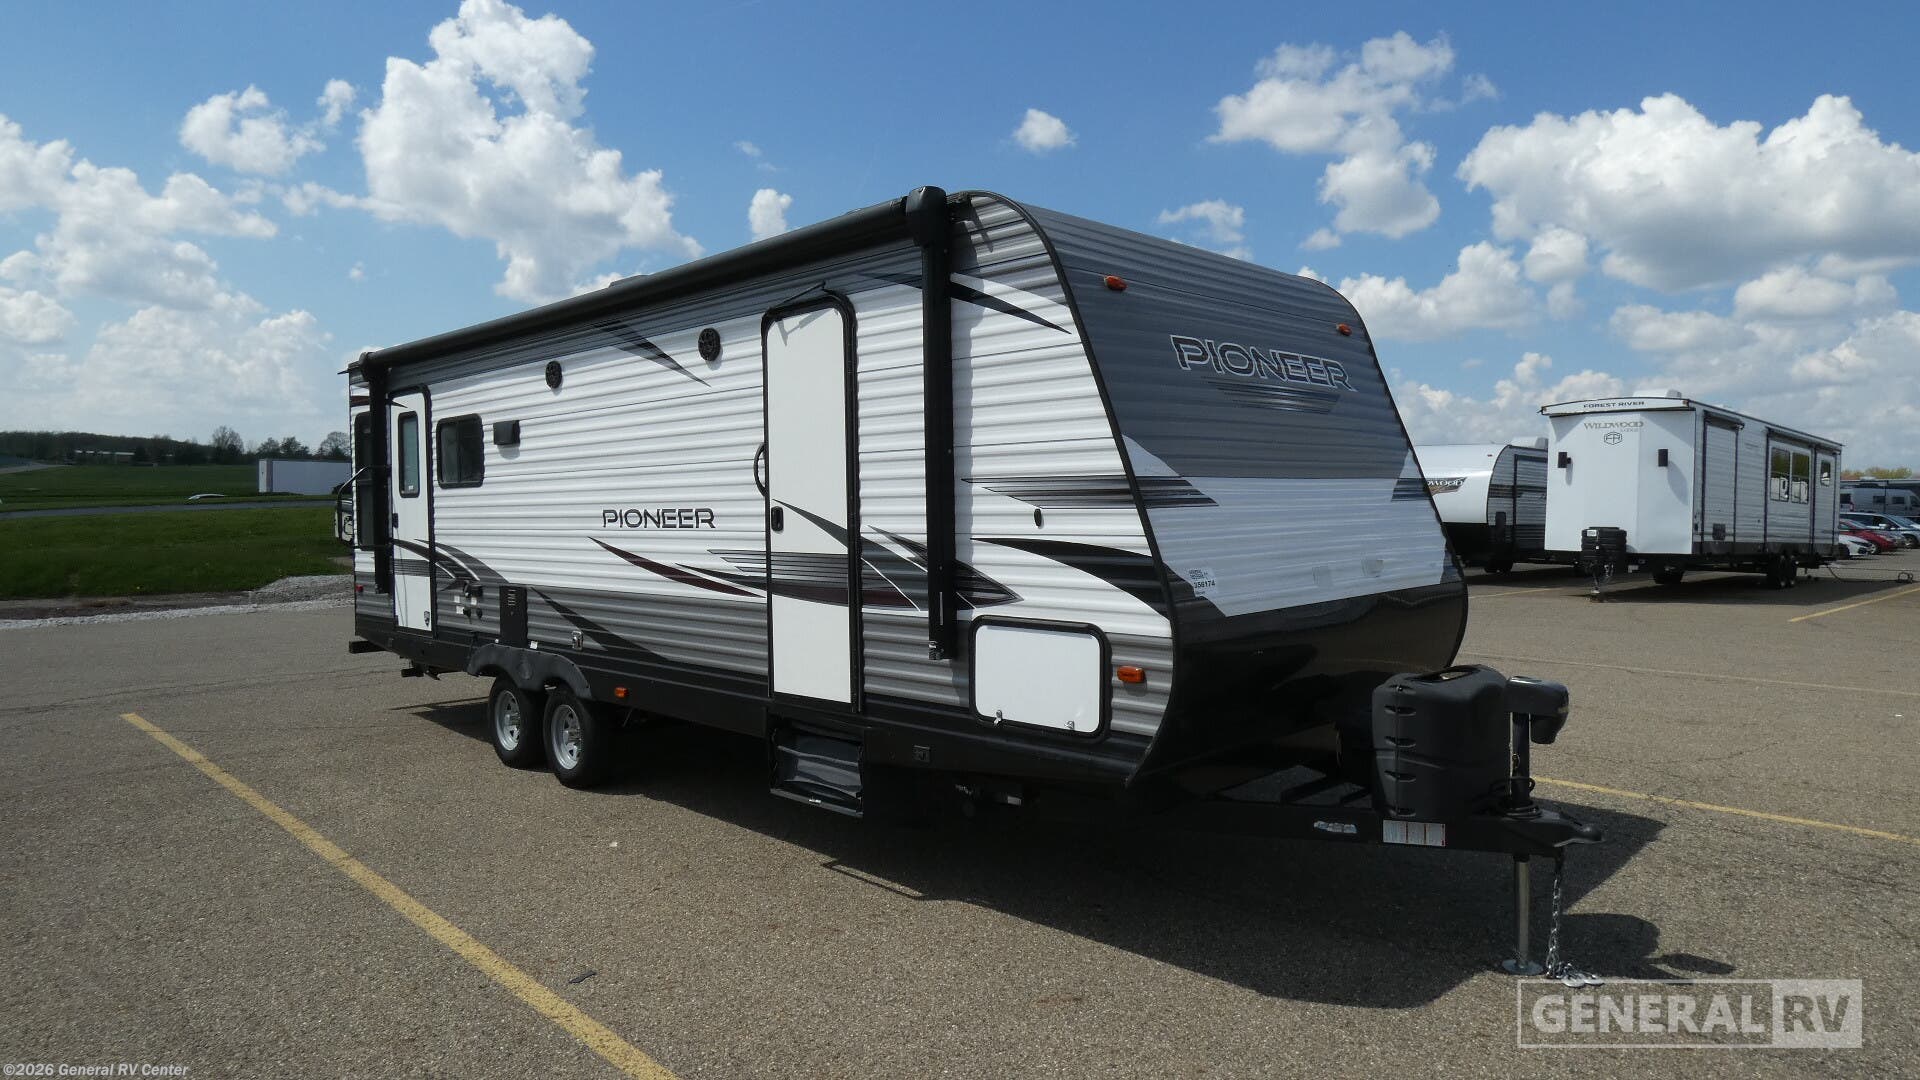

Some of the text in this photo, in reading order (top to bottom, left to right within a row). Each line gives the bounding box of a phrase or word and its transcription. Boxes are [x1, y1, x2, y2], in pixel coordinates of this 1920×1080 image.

[1170, 334, 1358, 392] PIONEER
[1584, 421, 1644, 430] WILDWOOD
[602, 508, 716, 529] PIONEER
